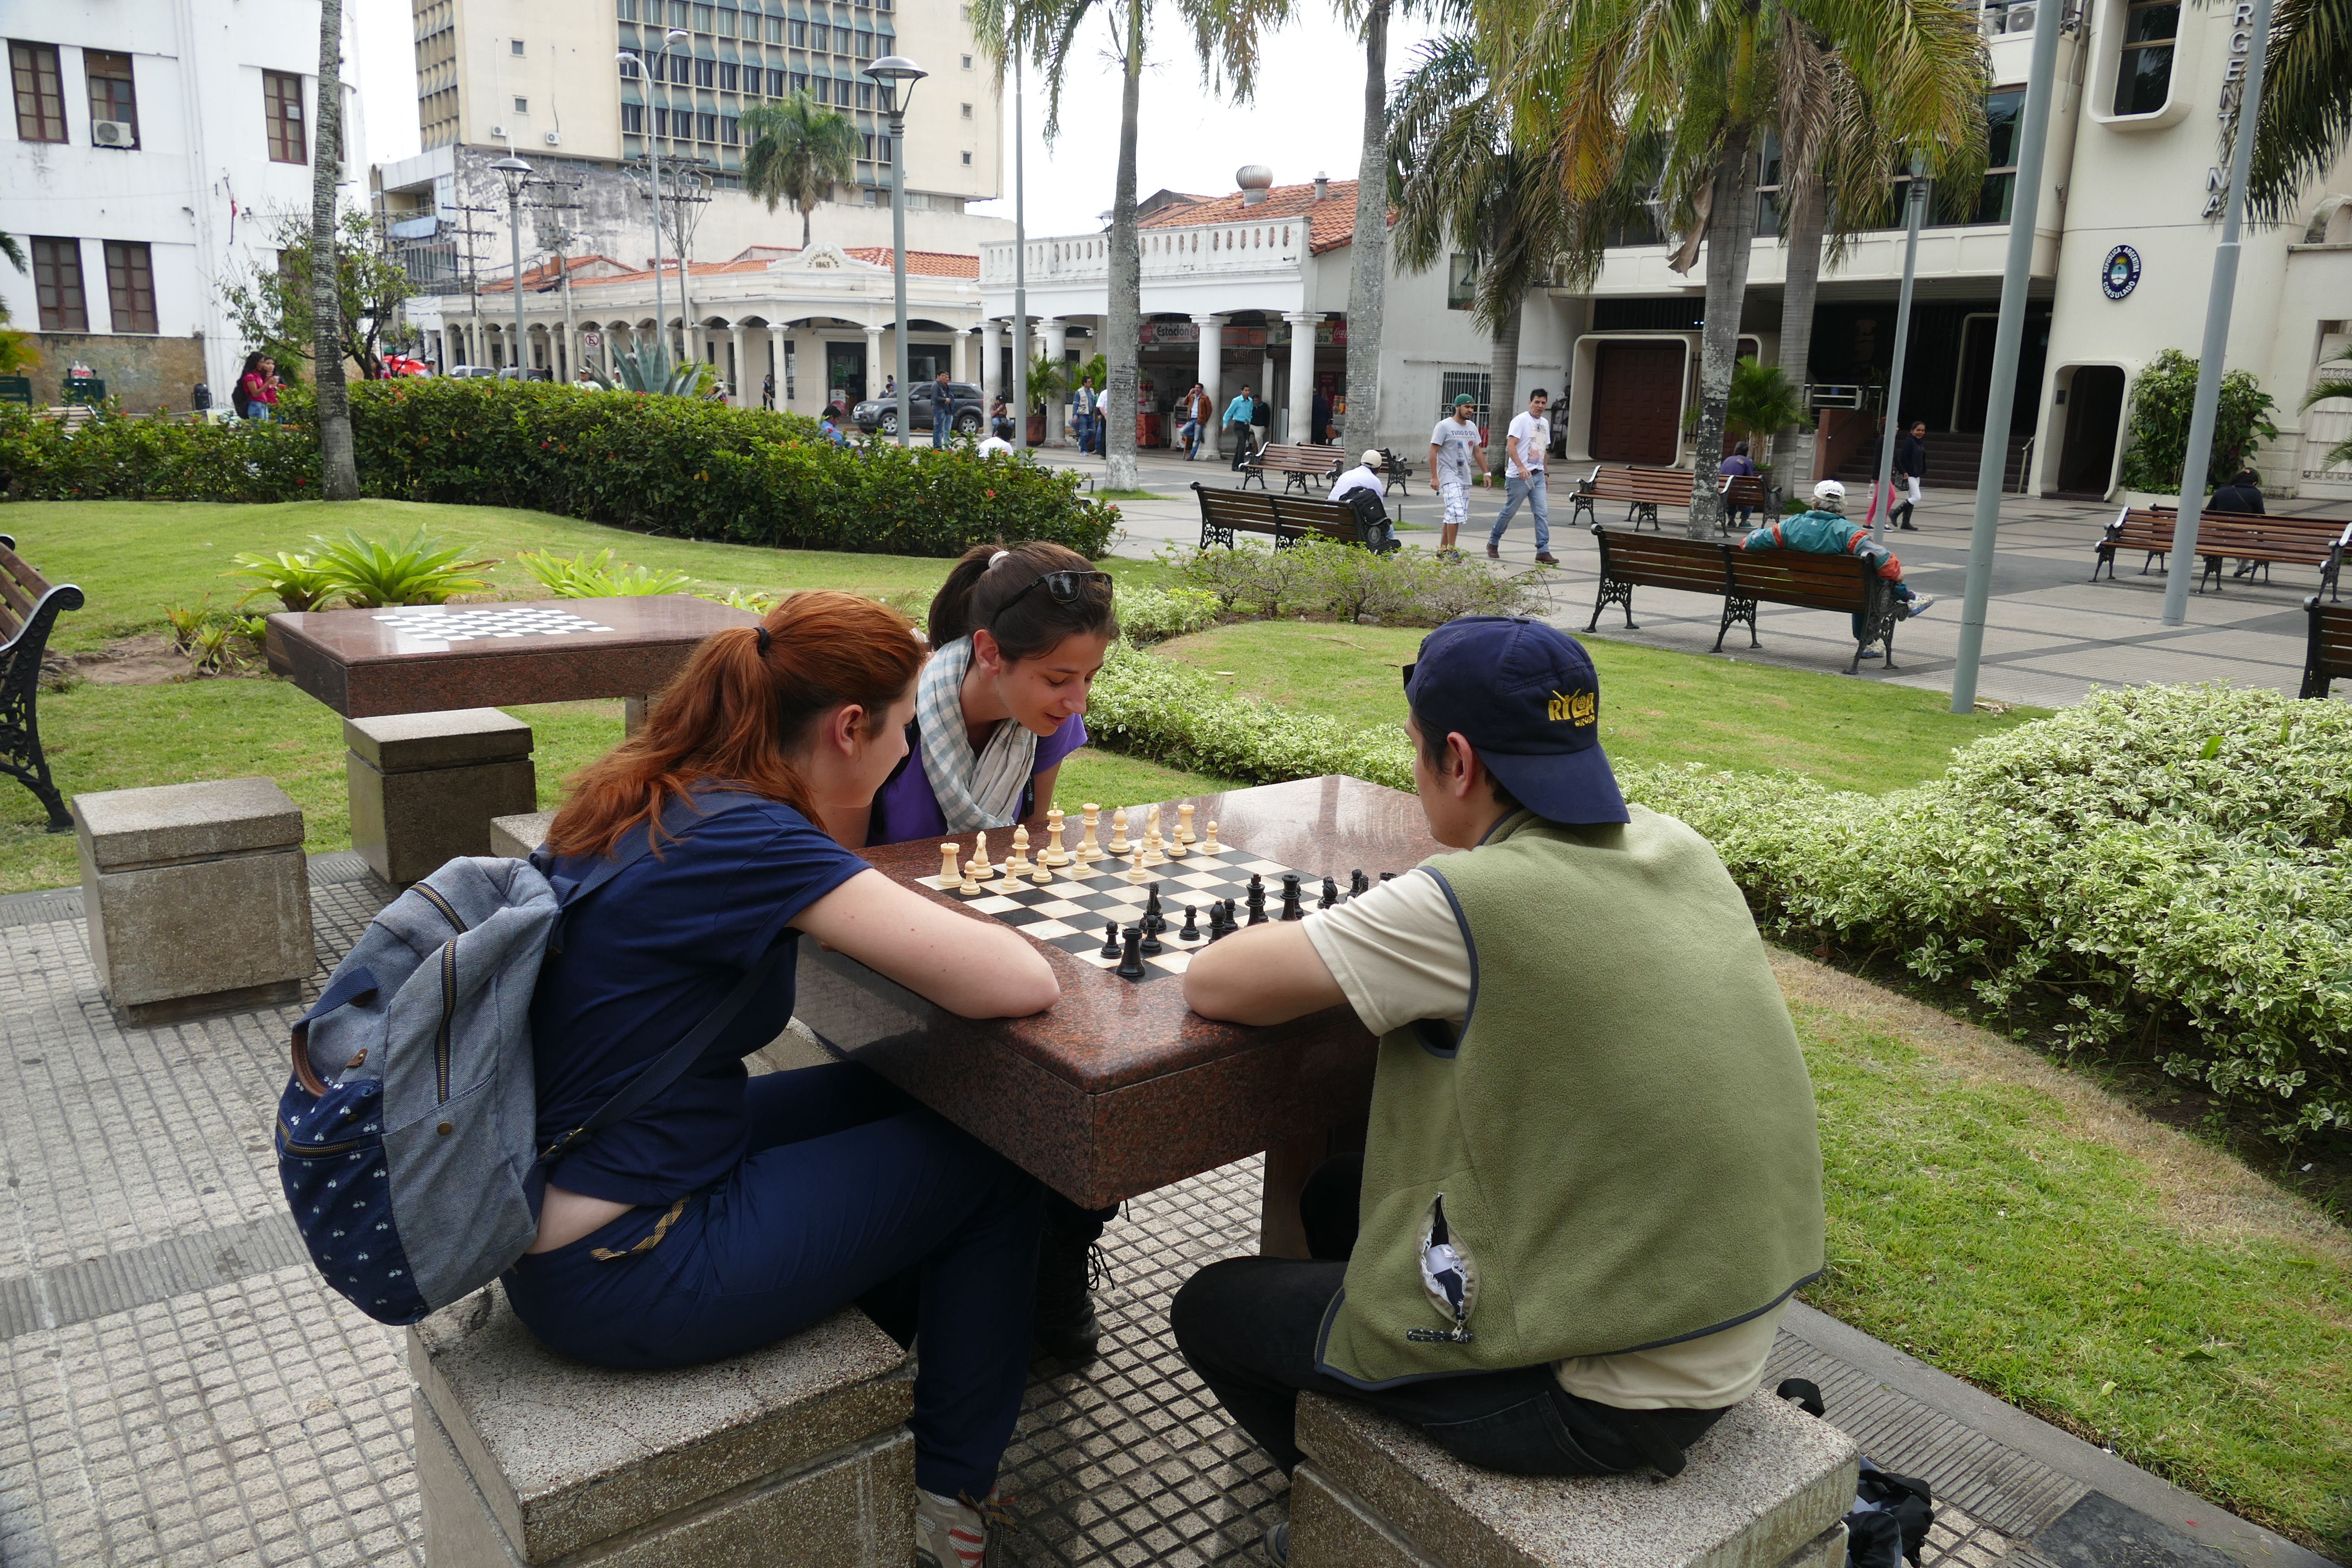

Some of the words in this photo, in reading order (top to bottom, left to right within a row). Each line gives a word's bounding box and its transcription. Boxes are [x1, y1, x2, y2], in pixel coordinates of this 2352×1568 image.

[2201, 1, 2255, 217] RGENTINA
[2103, 247, 2121, 273] REPUBLICA
[2122, 247, 2140, 273] ARGENTINA
[2103, 281, 2135, 298] CONSULADO
[1157, 325, 1189, 336] Estación
[1548, 688, 1595, 721] RYLA
